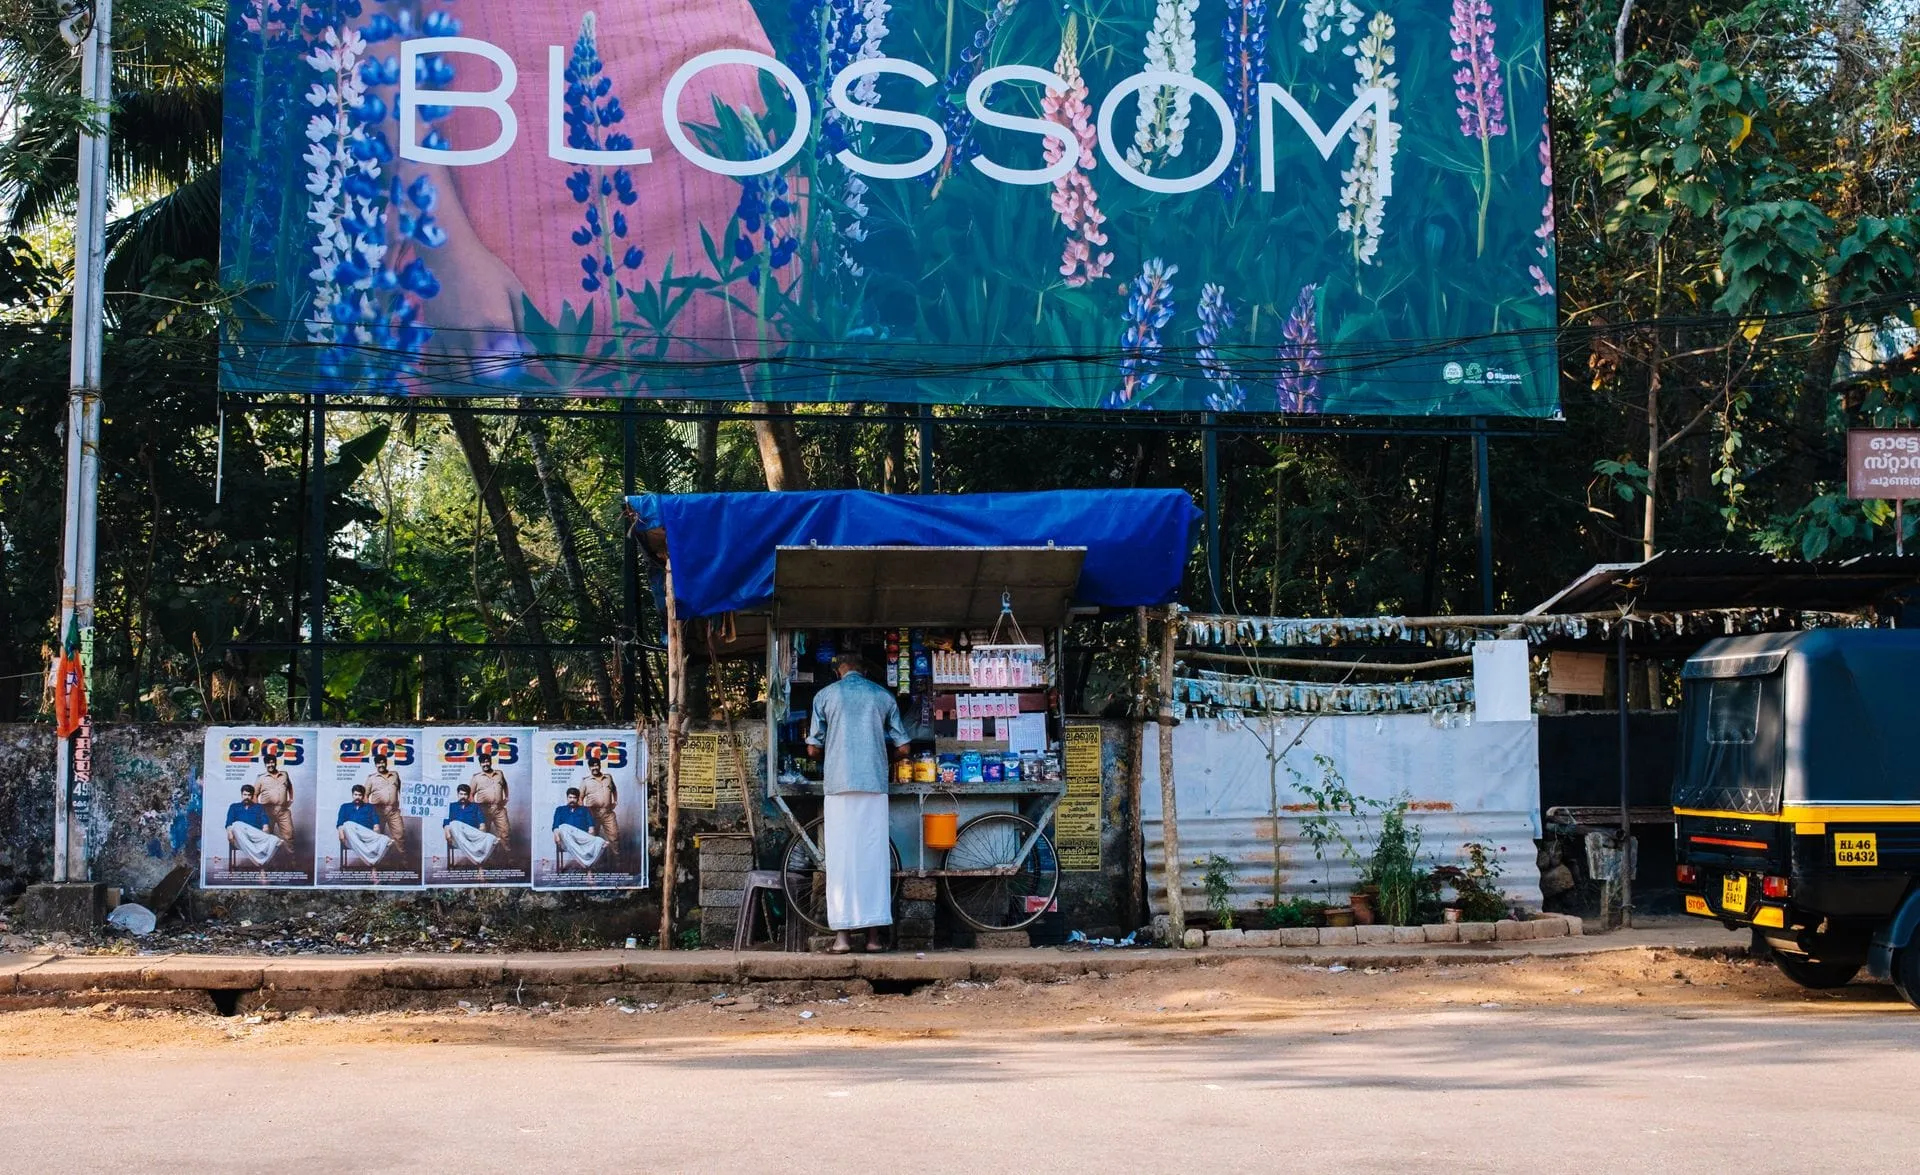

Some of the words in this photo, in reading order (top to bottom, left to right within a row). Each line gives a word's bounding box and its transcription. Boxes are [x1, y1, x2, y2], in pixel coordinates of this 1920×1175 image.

[400, 36, 1393, 197] BLOSSOM
[1840, 840, 1853, 849] KL
[1855, 840, 1871, 849] 46
[1838, 851, 1875, 862] G8432
[1688, 899, 1705, 910] STOP
